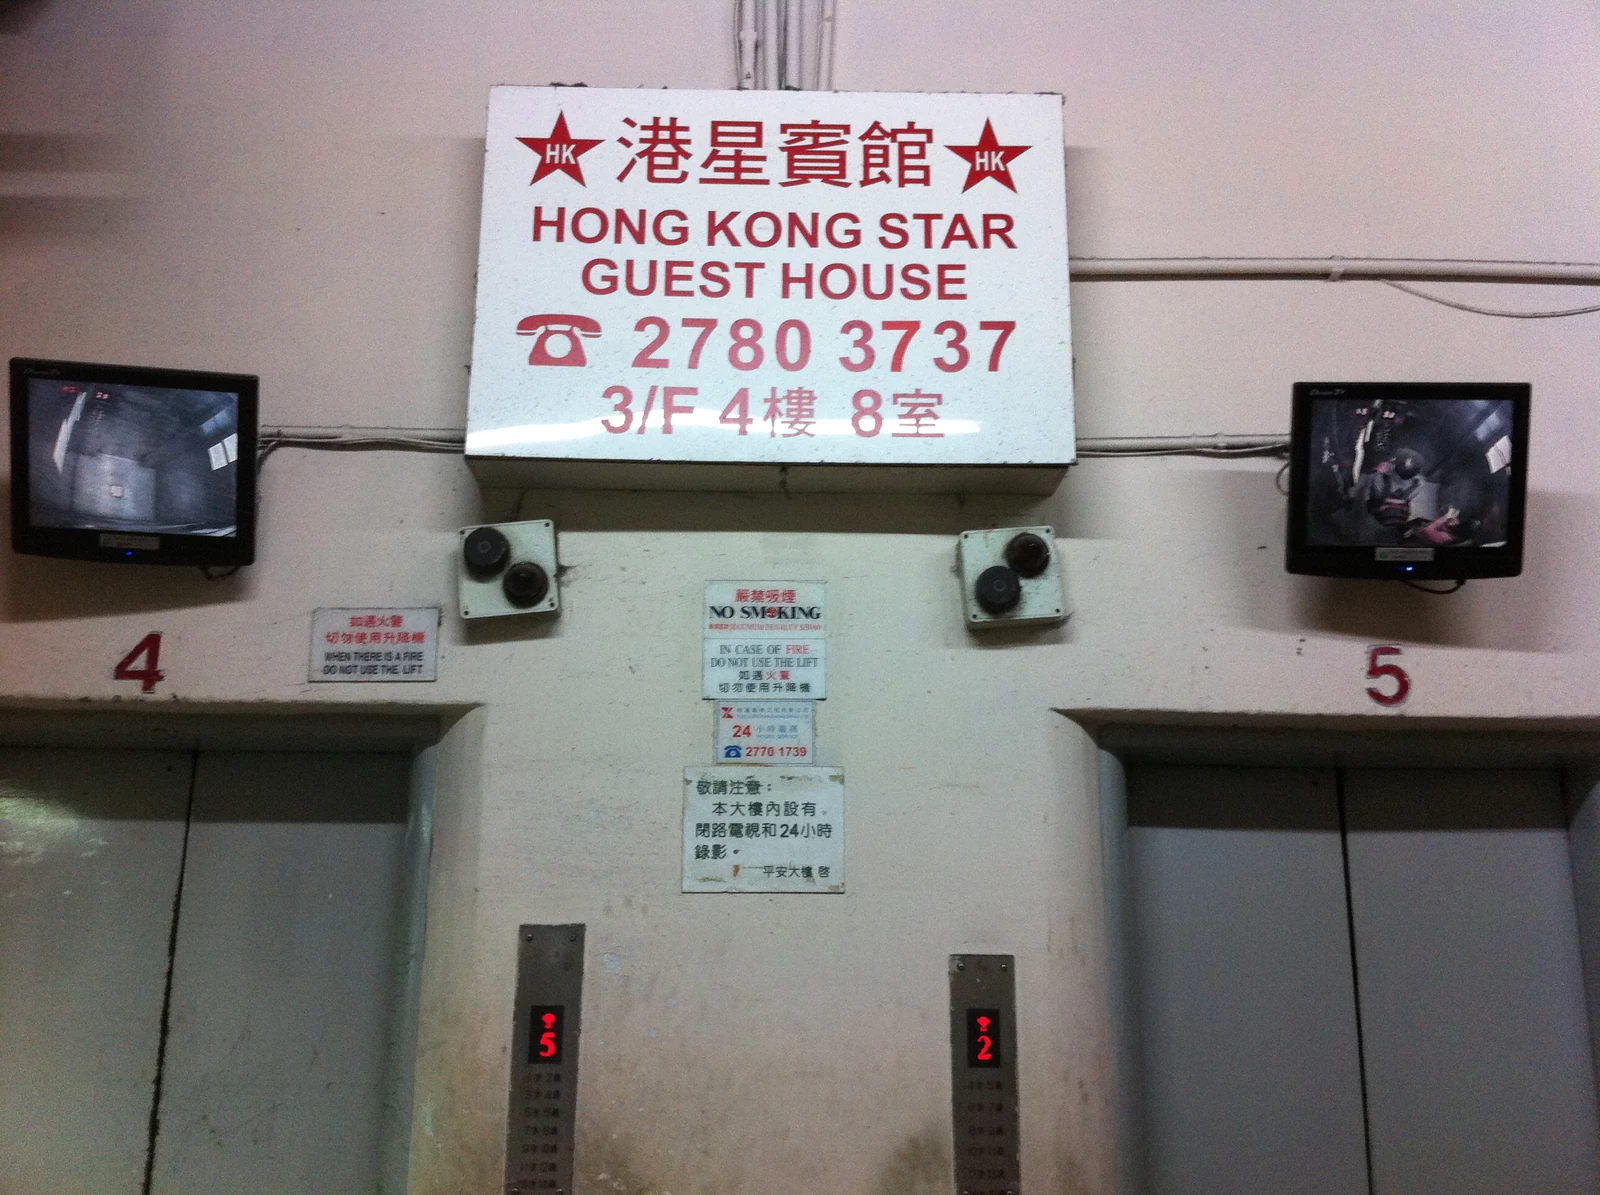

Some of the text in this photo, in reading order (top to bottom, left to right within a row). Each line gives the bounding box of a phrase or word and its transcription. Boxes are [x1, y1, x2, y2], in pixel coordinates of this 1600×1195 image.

[545, 144, 577, 165] HK
[616, 116, 933, 188] 港星賓館
[975, 150, 1005, 172] HK
[533, 206, 1017, 250] HONG KONG STAR
[581, 257, 968, 301] GUEST HOUSE
[632, 315, 1017, 373] 2780 3737
[601, 385, 699, 436] 3/F
[709, 606, 735, 619] NO
[113, 631, 165, 691] 4
[324, 651, 424, 661] WHEN THERE IS A FIRE
[720, 645, 810, 654] IN CASE OF FIRE
[323, 665, 424, 675] DO NOT USE THE LIFT
[710, 658, 818, 667] DO NOT USE THE LIFT
[1365, 645, 1410, 706] 5
[732, 725, 752, 737] 24
[745, 746, 807, 757] 2770 1739
[539, 1032, 556, 1057] 5
[977, 1035, 992, 1060] 2
